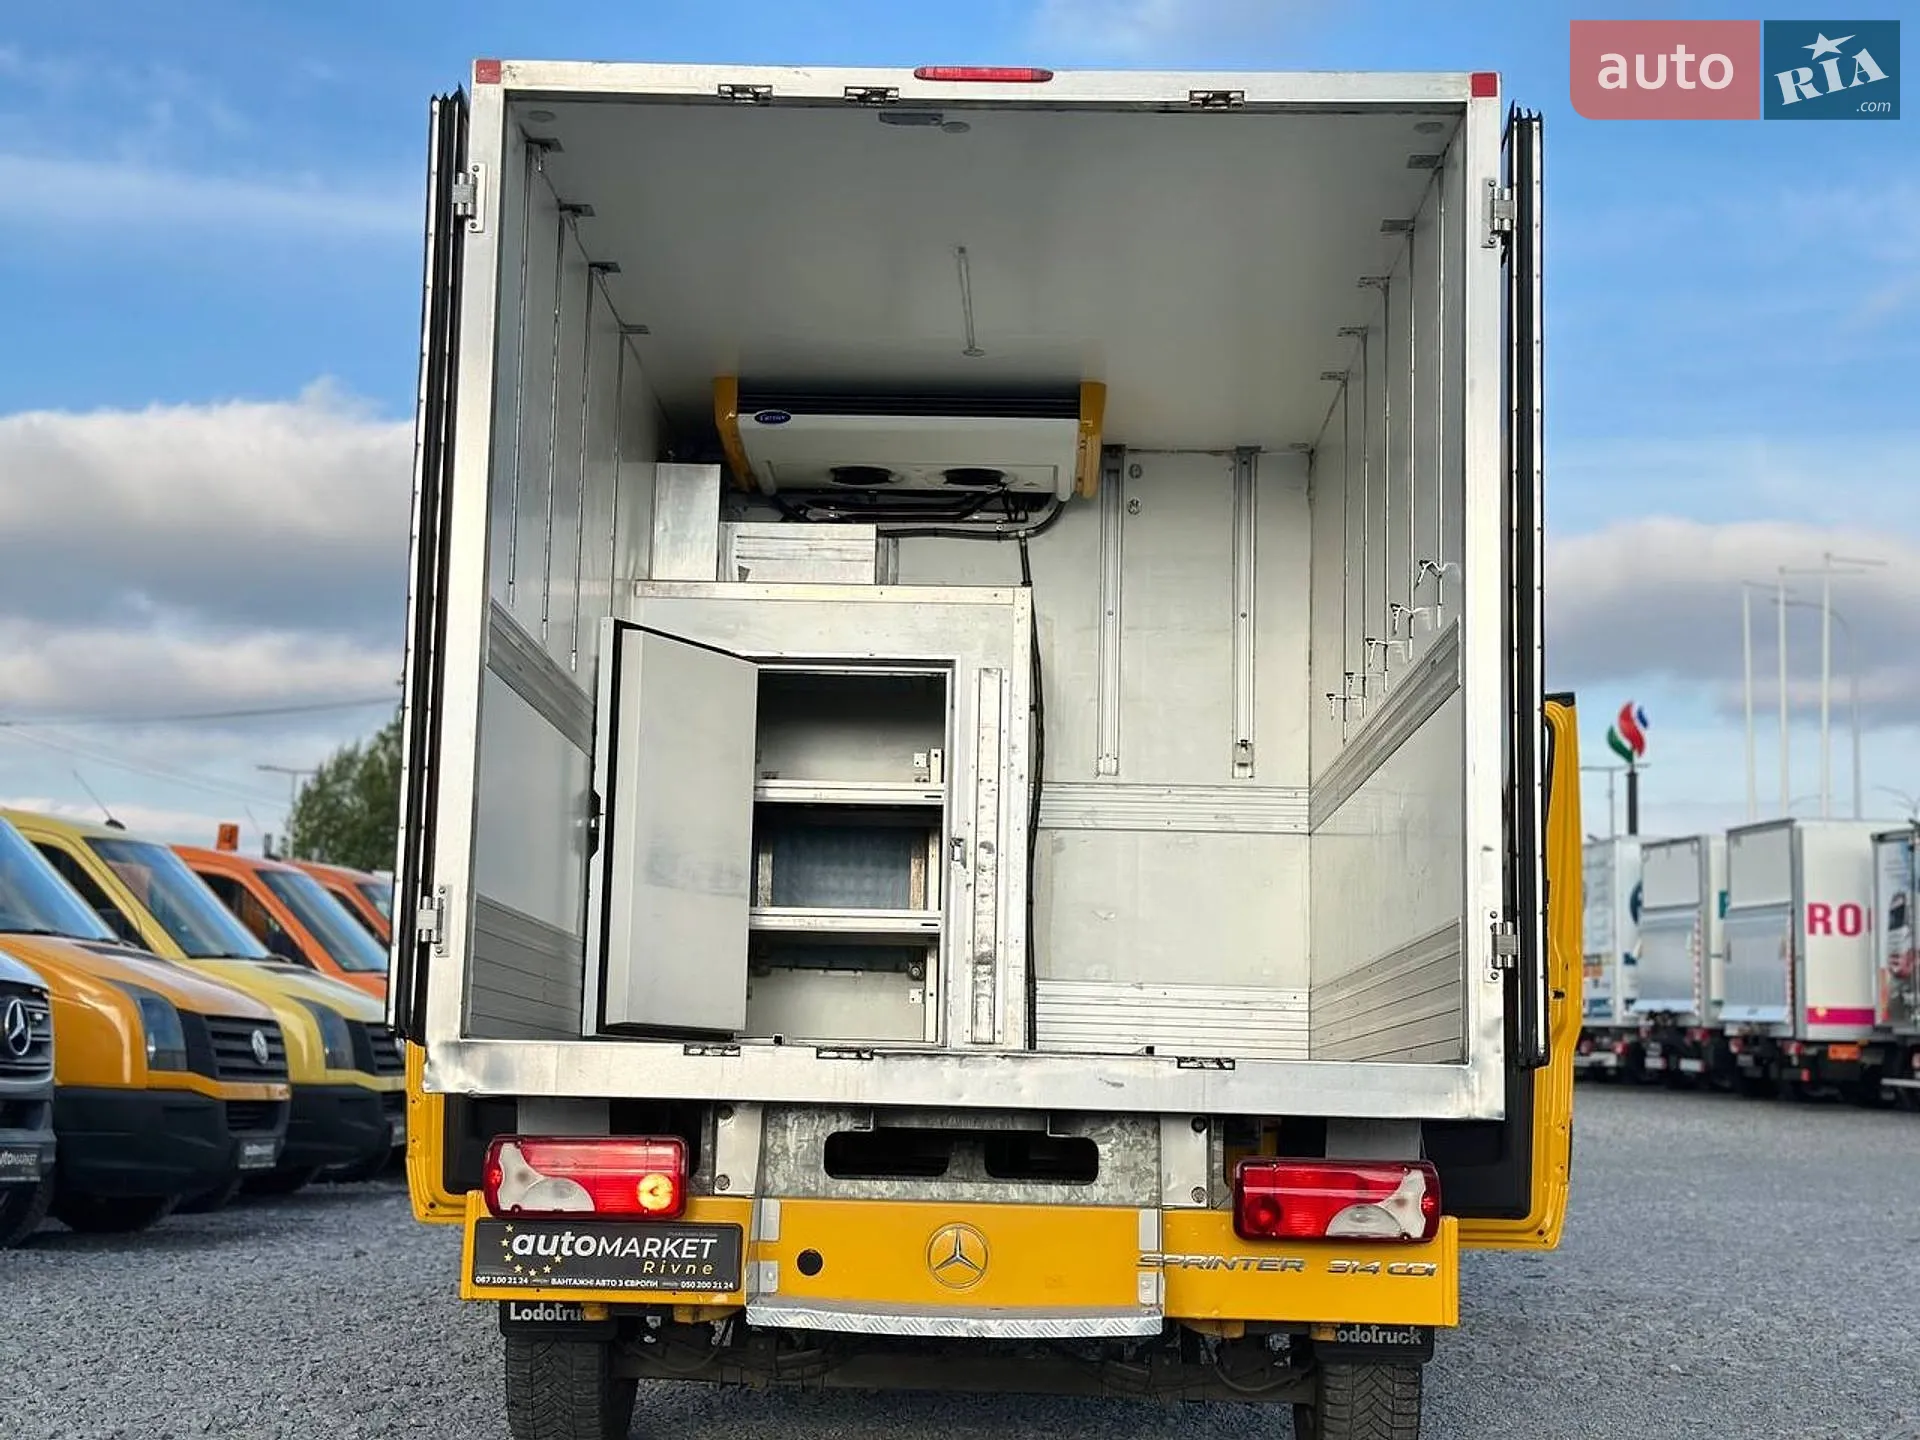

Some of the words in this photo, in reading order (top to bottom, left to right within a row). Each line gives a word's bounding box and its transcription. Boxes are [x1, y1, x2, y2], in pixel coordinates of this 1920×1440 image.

[1807, 902, 1872, 937] RO
[643, 1261, 715, 1276] Rivne
[1137, 1253, 1307, 1273] SPRINTER
[1327, 1259, 1380, 1275] 314
[1387, 1261, 1437, 1277] CDI
